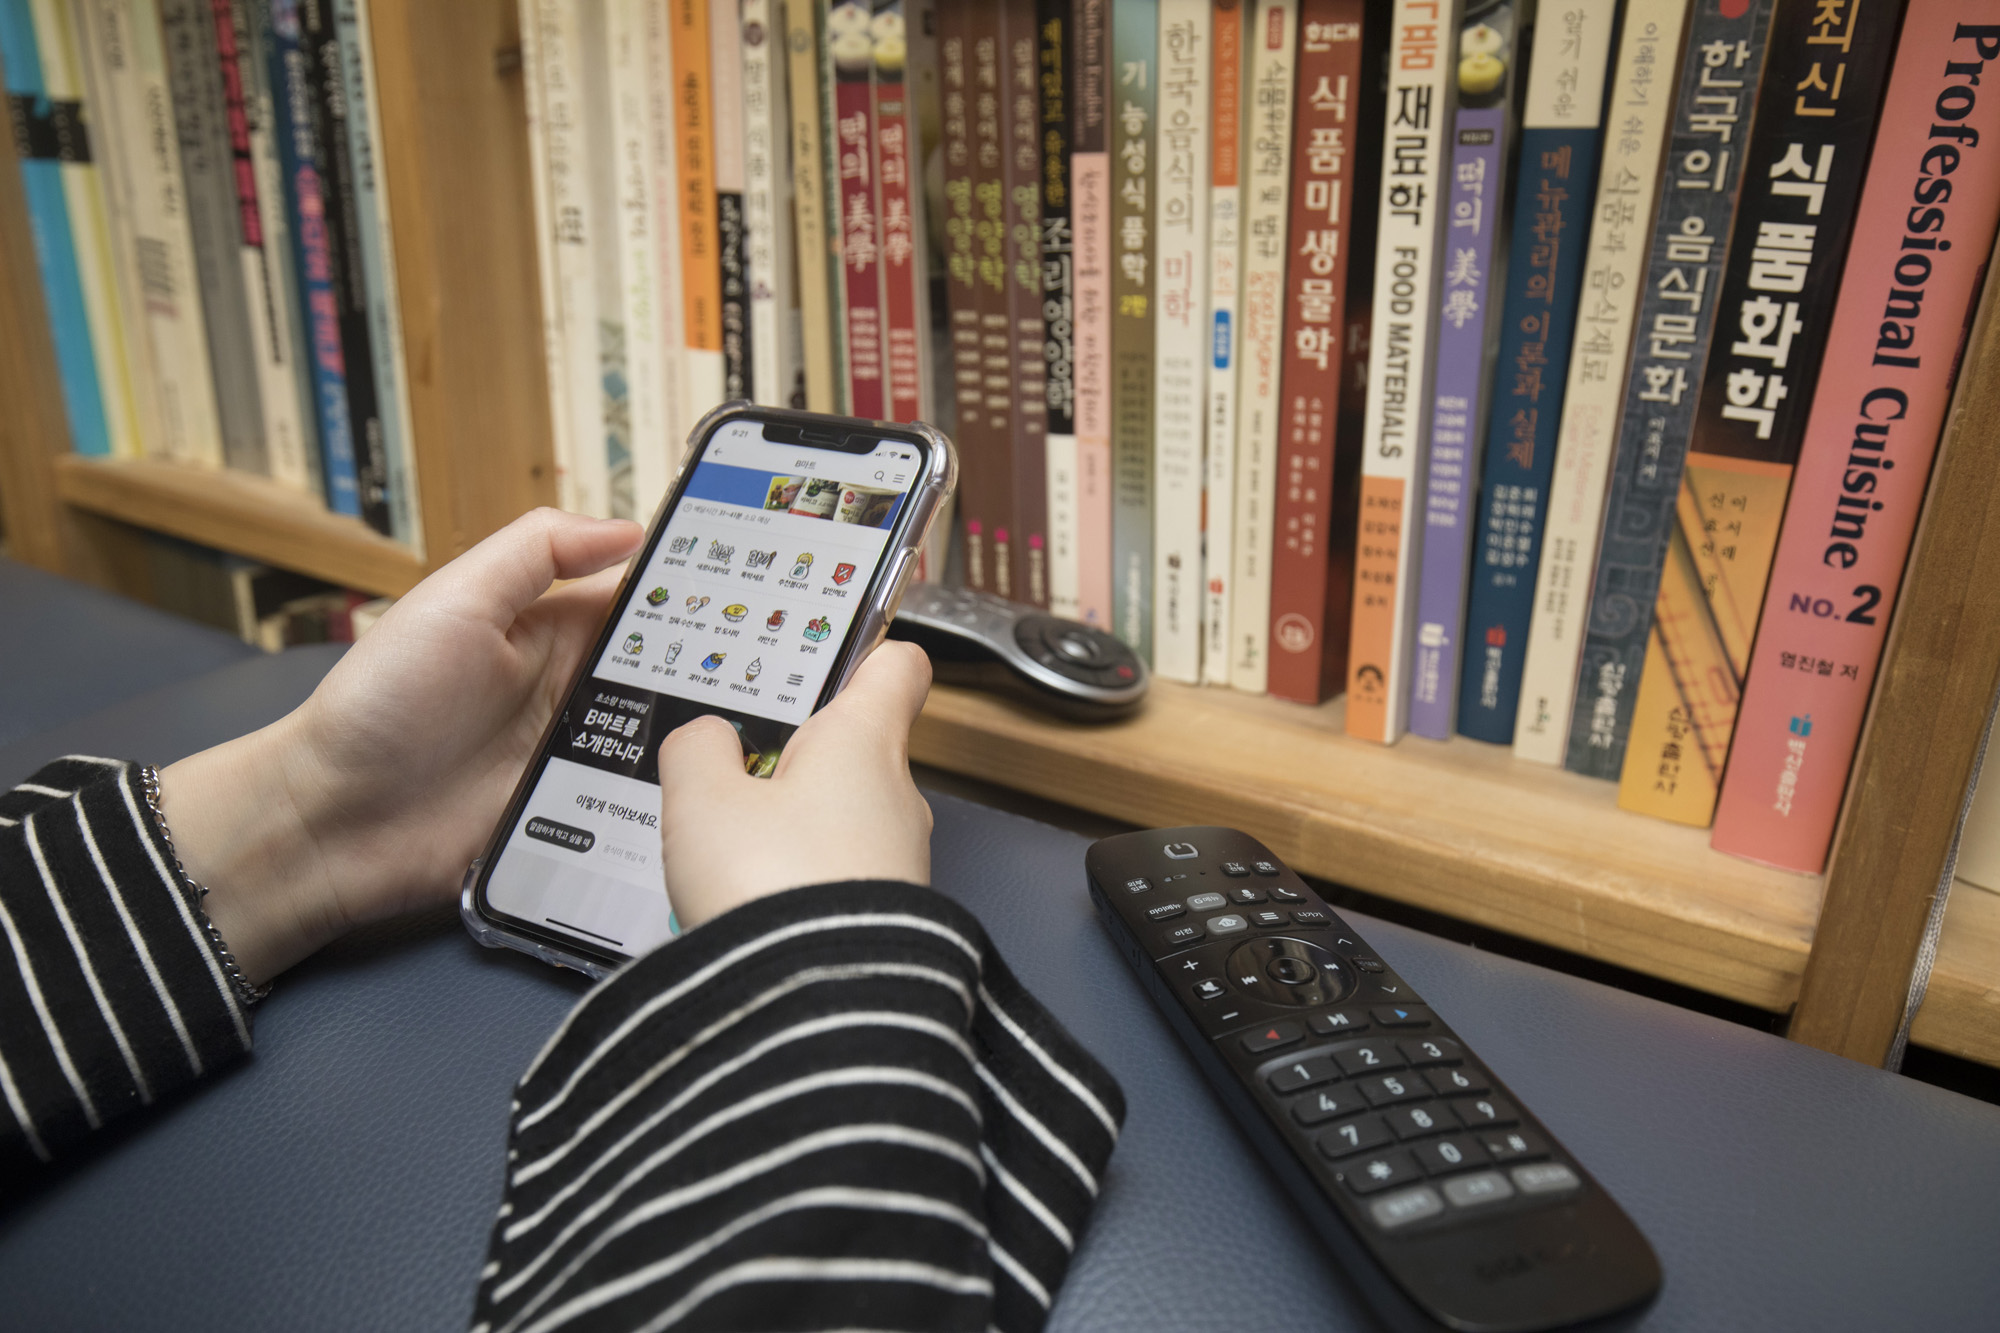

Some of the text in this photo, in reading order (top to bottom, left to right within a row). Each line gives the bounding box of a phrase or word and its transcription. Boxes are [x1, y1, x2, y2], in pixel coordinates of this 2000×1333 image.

[1304, 22, 1360, 52] 현대
[1795, 0, 1861, 117] 최신
[1163, 20, 1202, 235] 한국음식의
[1120, 59, 1149, 288] 기능성식품학
[1389, 84, 1433, 227] 재료학
[1453, 157, 1486, 237] 떡의
[1580, 21, 1660, 384] 이해하기 쉬운 식품과 음식재료
[1296, 75, 1349, 370] 식품미생물학
[1638, 40, 1752, 406] 한국의 음식문화
[1390, 245, 1418, 315] FOOD
[1721, 142, 1836, 440] 식품화학
[1824, 22, 2000, 570] Professional Cuisine
[1379, 323, 1414, 460] MATERIALS
[731, 428, 749, 438] 9:21
[794, 459, 817, 470] B마트
[1788, 584, 1882, 626] NO. 2
[1780, 650, 1860, 682] 염진철 저
[594, 692, 650, 715] 초소량 번쩍배달
[729, 683, 761, 697] 아이스크림
[776, 693, 797, 705] 더보기
[583, 708, 641, 738] B마트를
[572, 731, 645, 765] 소개합니다
[576, 794, 659, 829] 이렇게 먹어보세요,
[529, 821, 592, 848] 깔끔하게 먹고 싶을 때
[1174, 927, 1194, 937] 이전
[1293, 1042, 1443, 1081] 1 2 3
[1318, 1070, 1470, 1112] 4 5 6
[1339, 1101, 1496, 1146] 7 8 9
[1438, 1142, 1463, 1164] 0
